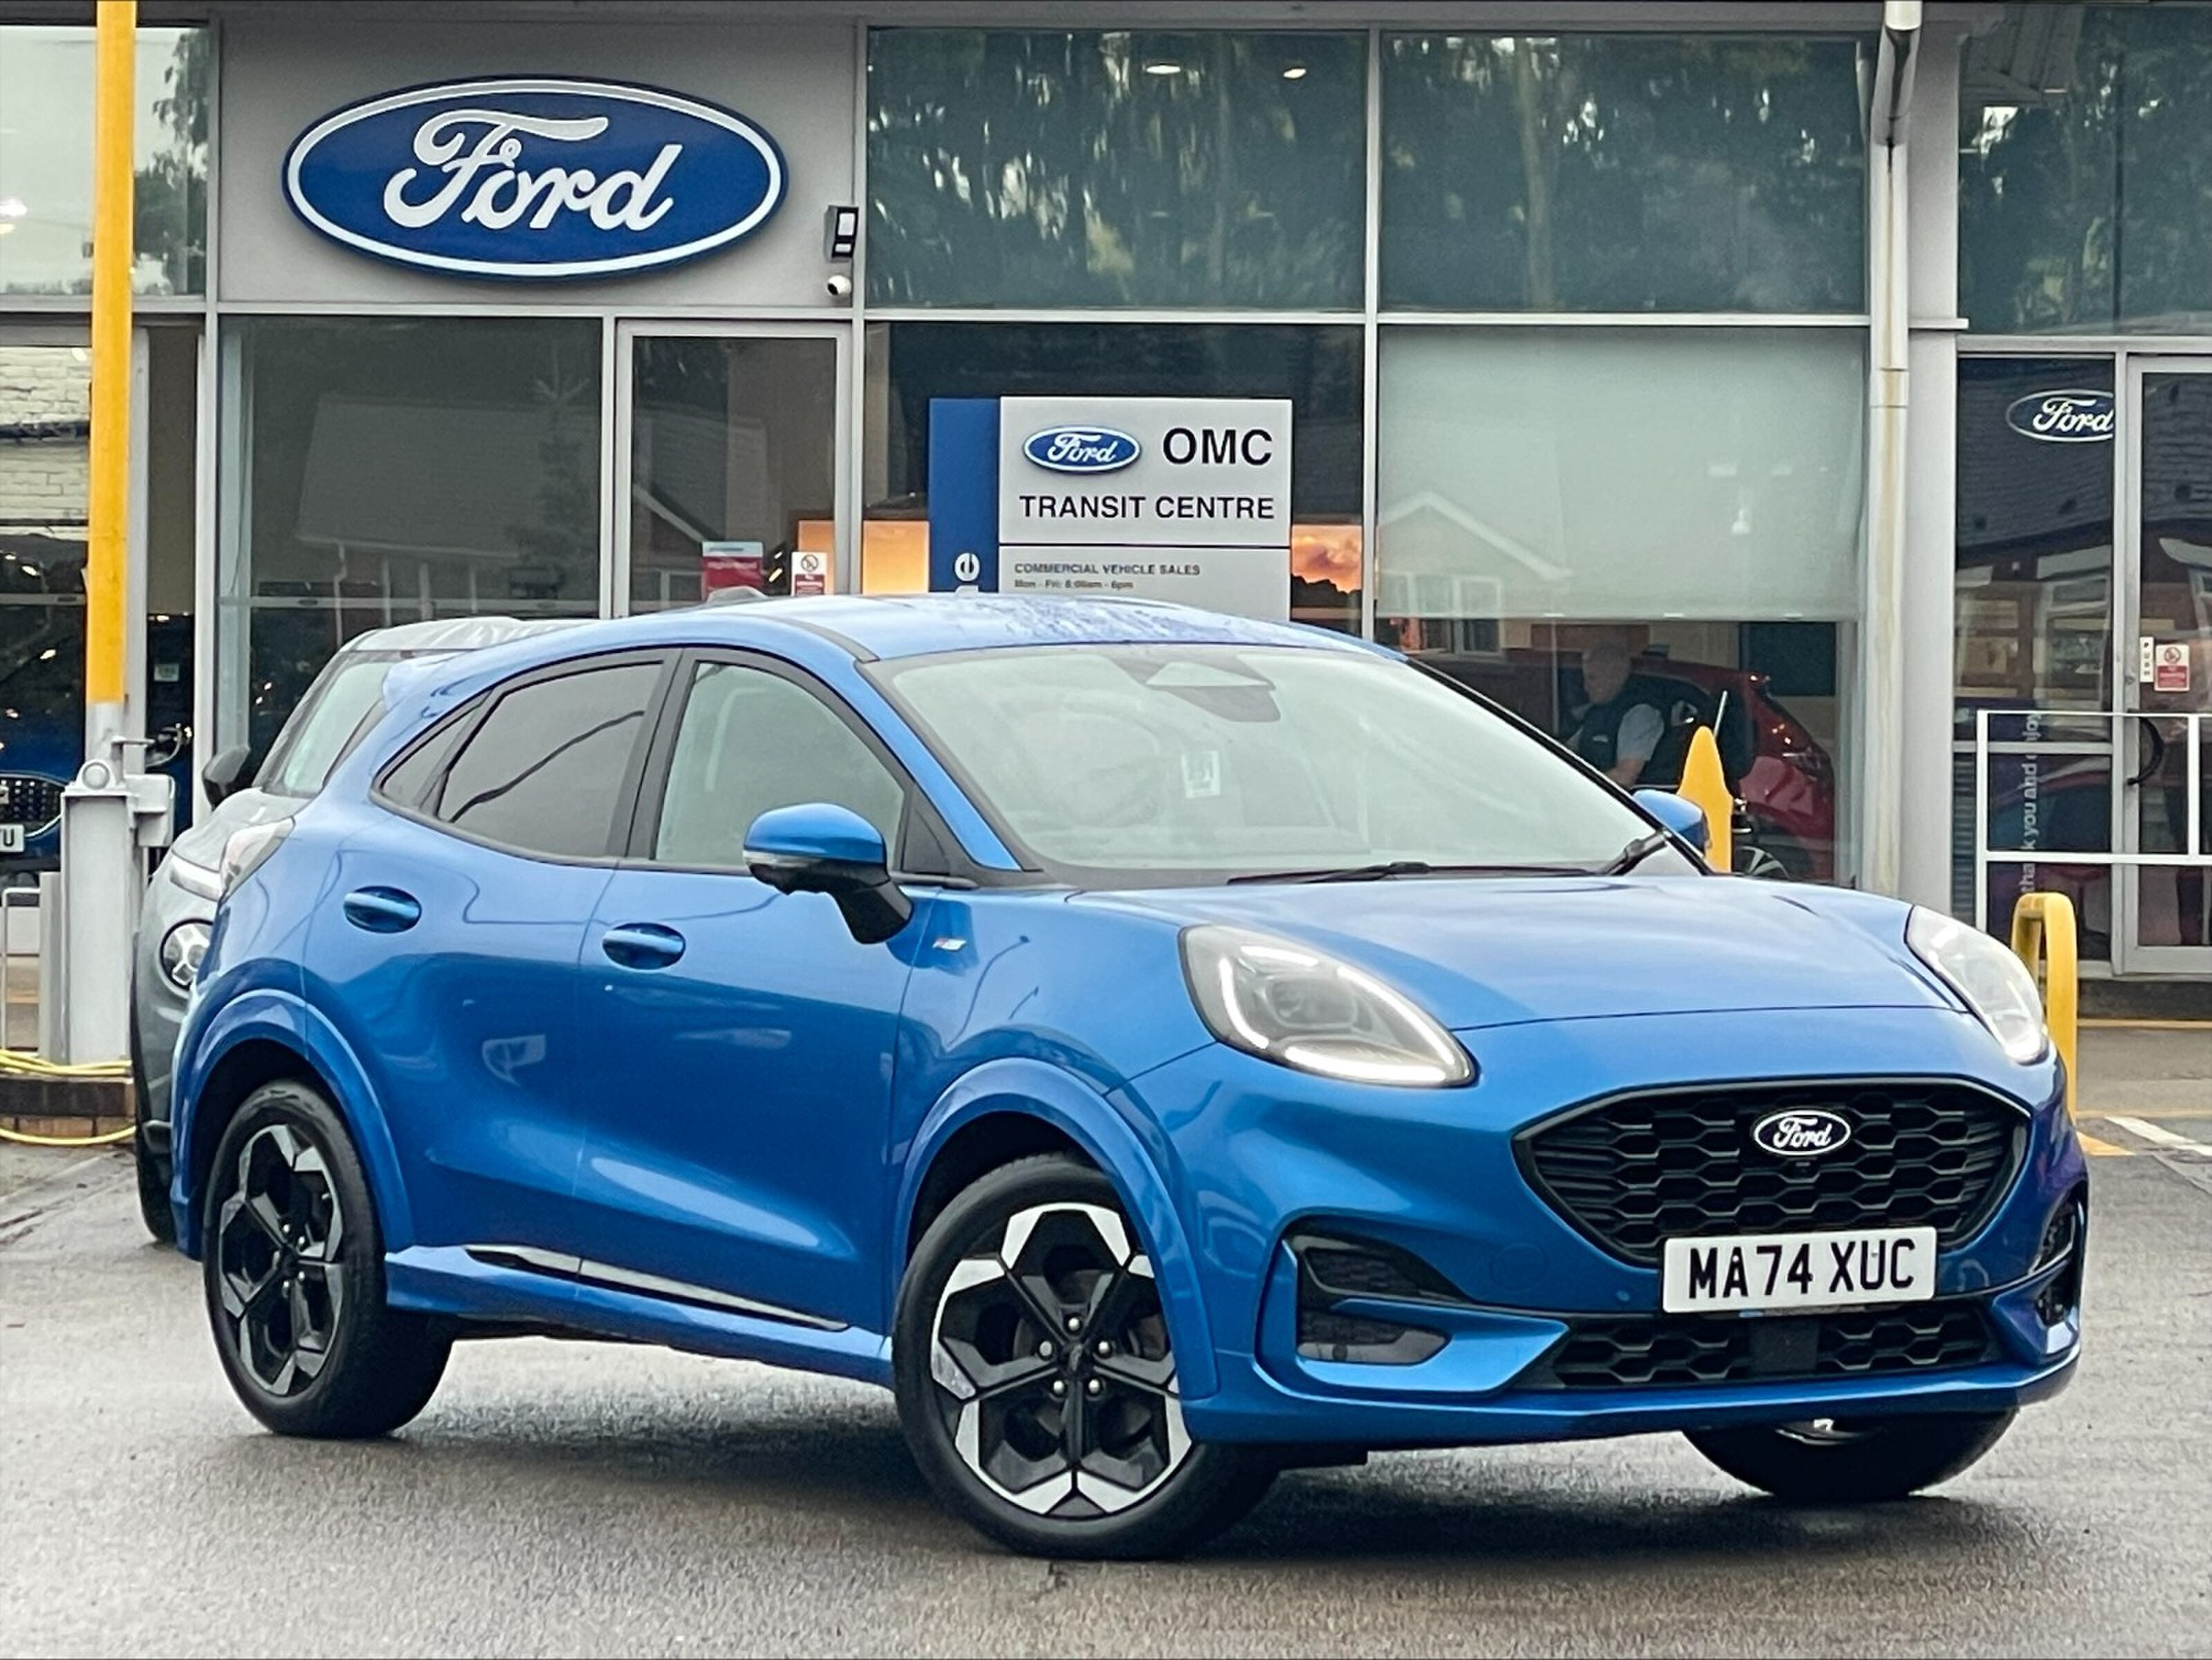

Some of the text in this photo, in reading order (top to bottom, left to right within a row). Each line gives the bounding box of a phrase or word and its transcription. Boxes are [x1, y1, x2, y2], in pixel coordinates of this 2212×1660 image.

[383, 109, 683, 231] Ford
[2032, 398, 2114, 432] Ford
[1047, 433, 1118, 462] Ford
[1163, 427, 1273, 465] OMC
[1019, 495, 1274, 519] TRANSIT CENTRE
[1014, 563, 1201, 576] COMMERCIAL VEHICLE SALES
[2021, 763, 2037, 800] and
[2024, 802, 2039, 837] you
[2019, 838, 2036, 893] thak
[1772, 1116, 1832, 1148] Ford
[1688, 1238, 1915, 1299] MA74 XUC
